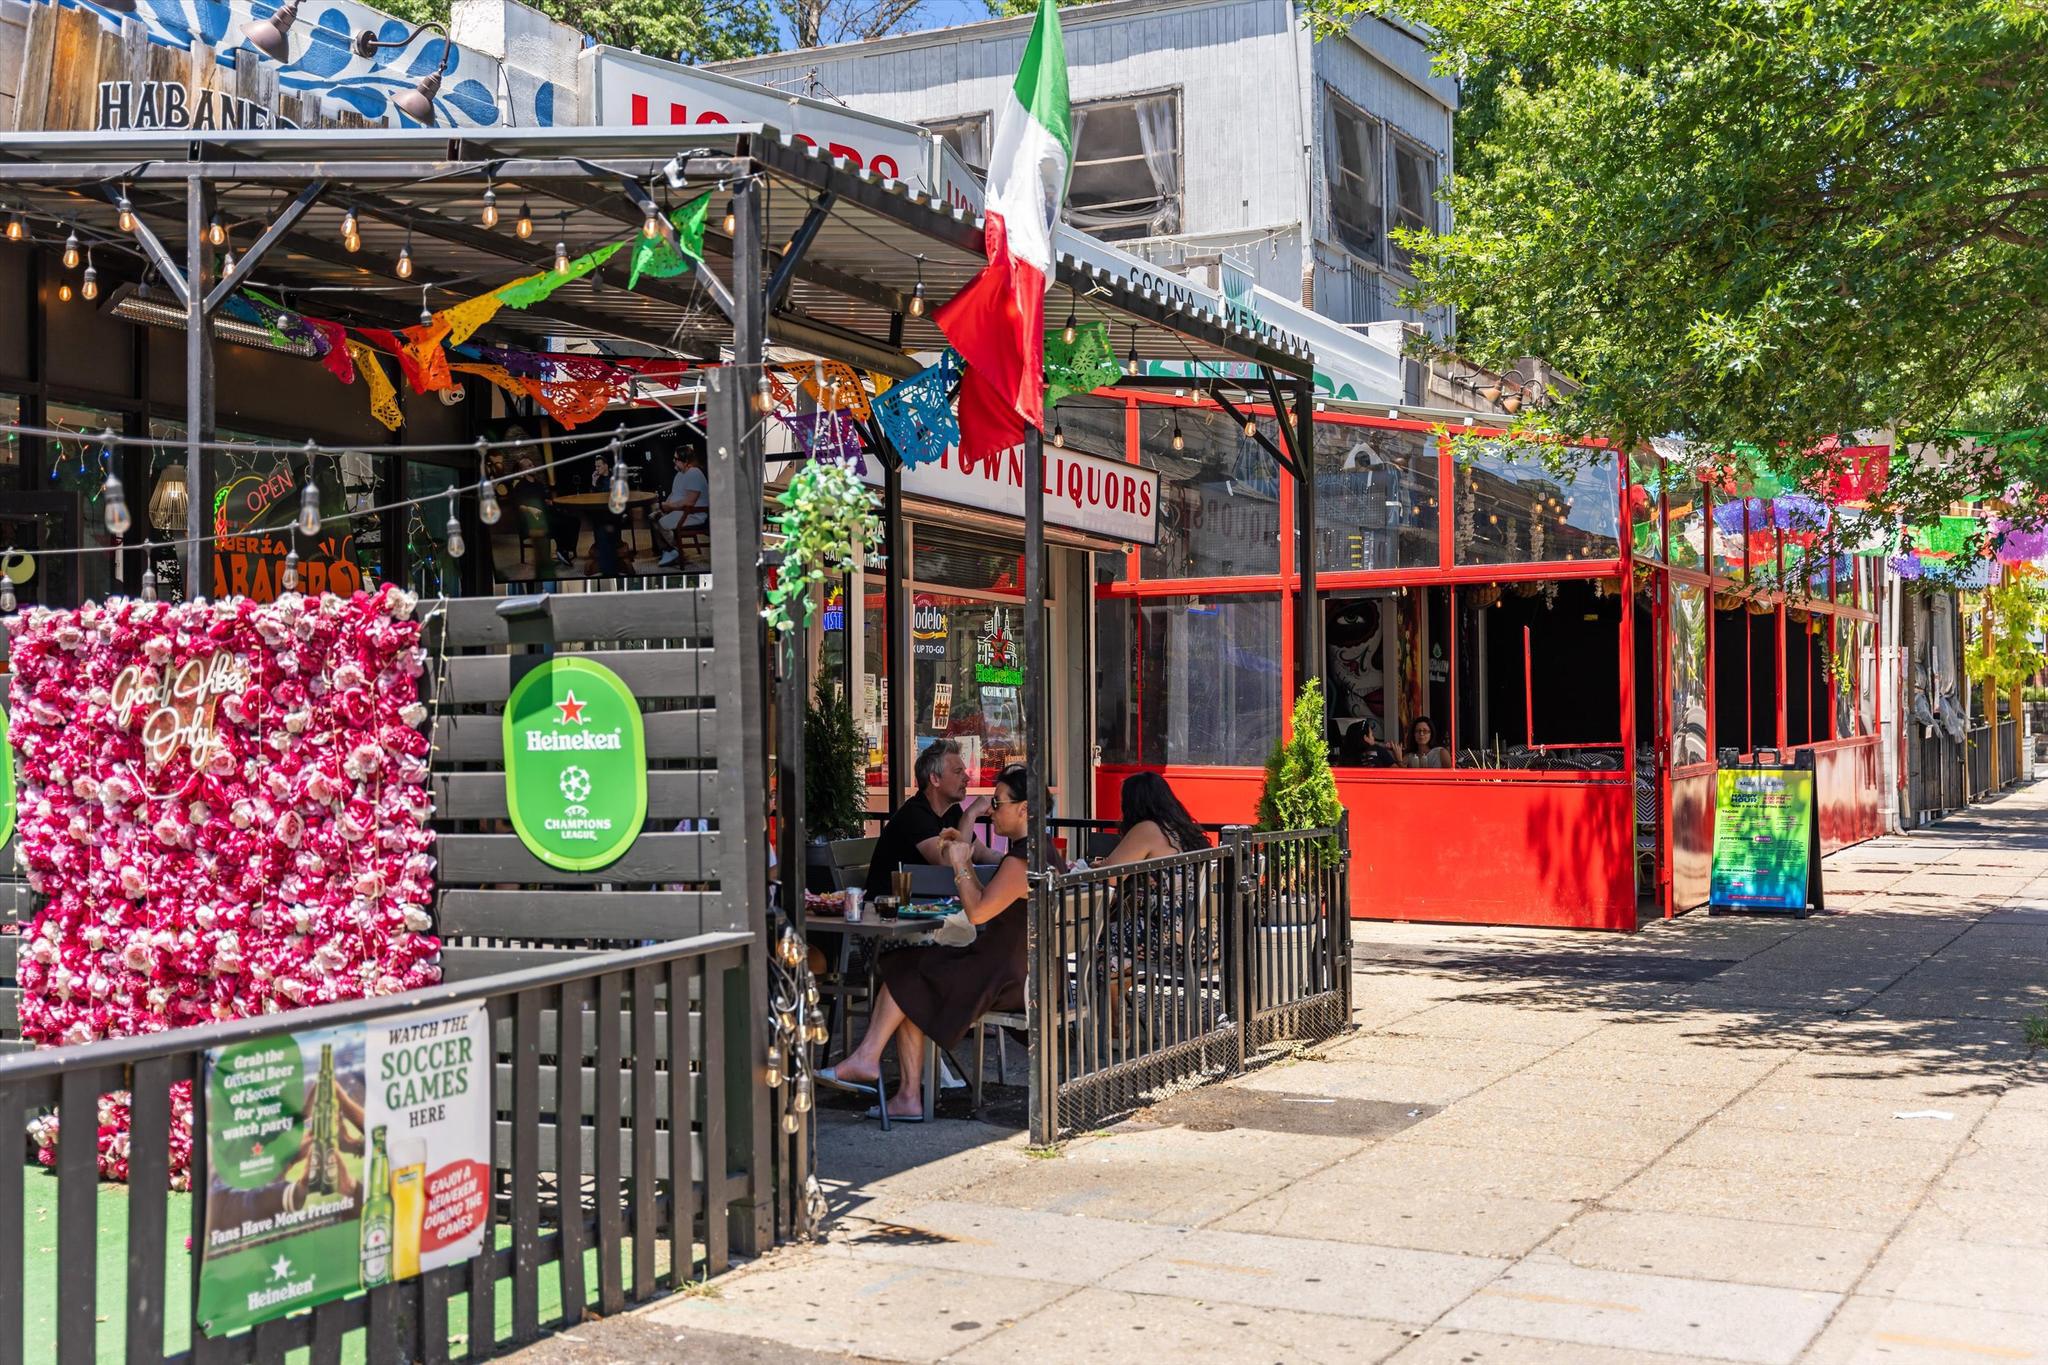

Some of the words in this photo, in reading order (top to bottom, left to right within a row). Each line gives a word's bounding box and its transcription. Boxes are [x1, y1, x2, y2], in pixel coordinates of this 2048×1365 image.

[1130, 267, 1196, 309] COCINA
[1224, 303, 1311, 352] MEXICANA
[247, 469, 293, 512] OPEN
[1042, 455, 1151, 518] LIQUORS
[912, 603, 942, 631] odelo
[925, 645, 945, 654] TO-GO
[111, 665, 172, 728] Good
[173, 649, 248, 706] Vibes
[142, 706, 222, 768] Only
[525, 729, 622, 751] Heineken
[544, 818, 612, 830] CHAMPIONS
[561, 830, 597, 841] LEAGUE
[389, 1020, 440, 1046] WATCH
[442, 1014, 469, 1035] THE
[234, 1053, 263, 1069] Grab
[264, 1049, 284, 1064] the
[381, 1036, 474, 1081] SOCCER
[223, 1068, 266, 1089] Official
[266, 1064, 295, 1080] Beer
[385, 1066, 469, 1111] GAMES
[229, 1091, 245, 1105] of
[233, 1107, 255, 1121] for
[255, 1102, 283, 1121] your
[222, 1121, 260, 1141] watch
[260, 1116, 294, 1137] party
[409, 1103, 446, 1129] HERE
[430, 1169, 463, 1195] ENJOY
[462, 1165, 472, 1180] A
[424, 1202, 464, 1230] DURING
[465, 1191, 484, 1211] THE
[428, 1178, 478, 1213] HEINEKEN
[210, 1227, 241, 1246] Fans
[242, 1217, 273, 1237] Have
[274, 1208, 306, 1229] More
[308, 1196, 355, 1220] Friends
[436, 1214, 473, 1240] GAMES
[247, 1277, 315, 1311] Heineken
